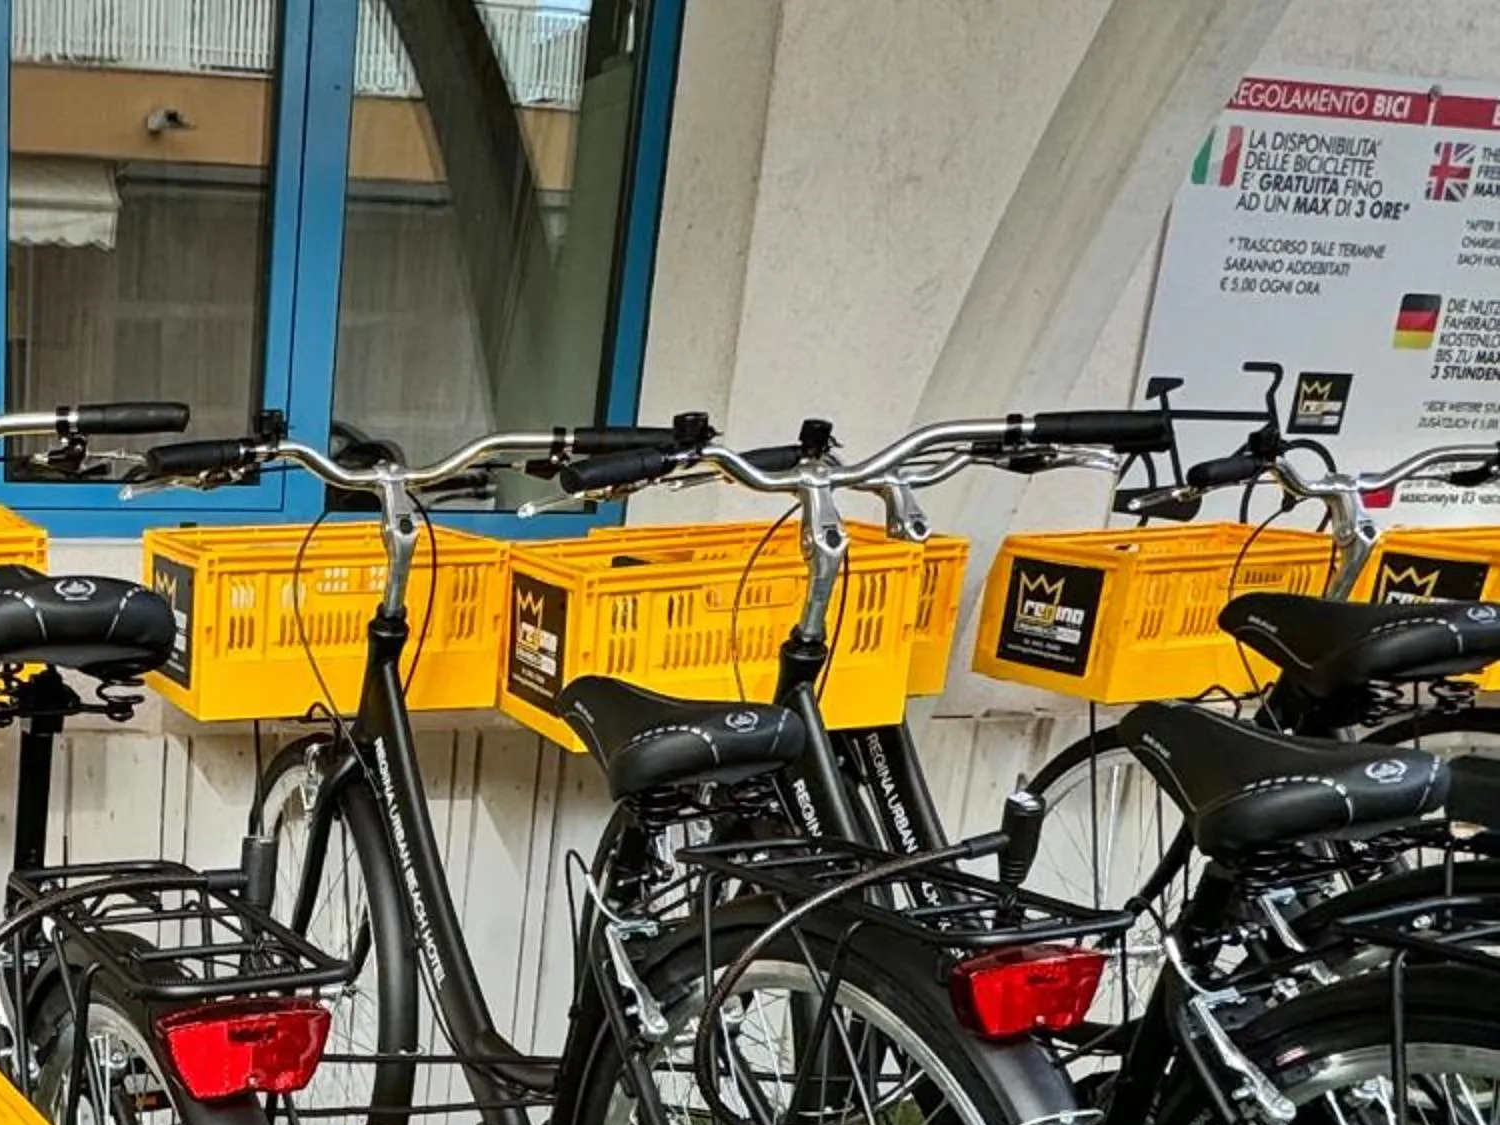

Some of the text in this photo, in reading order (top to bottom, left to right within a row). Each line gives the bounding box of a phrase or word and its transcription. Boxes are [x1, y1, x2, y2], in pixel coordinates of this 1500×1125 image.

[1372, 94, 1412, 119] BICI
[1249, 130, 1267, 149] LA
[1244, 152, 1375, 178] DELLE BICICLETTE
[1259, 174, 1340, 196] GRATUITA
[1343, 179, 1383, 199] FINO
[1235, 193, 1261, 211] AD
[1264, 195, 1290, 213] UN
[1292, 196, 1330, 216] MAX
[1335, 198, 1353, 217] DI
[1355, 200, 1367, 218] 3
[865, 732, 919, 854] REGINA URBAN
[793, 778, 823, 840] REGIN
[405, 867, 428, 931] BEACH
[421, 928, 446, 990] HOTEL
